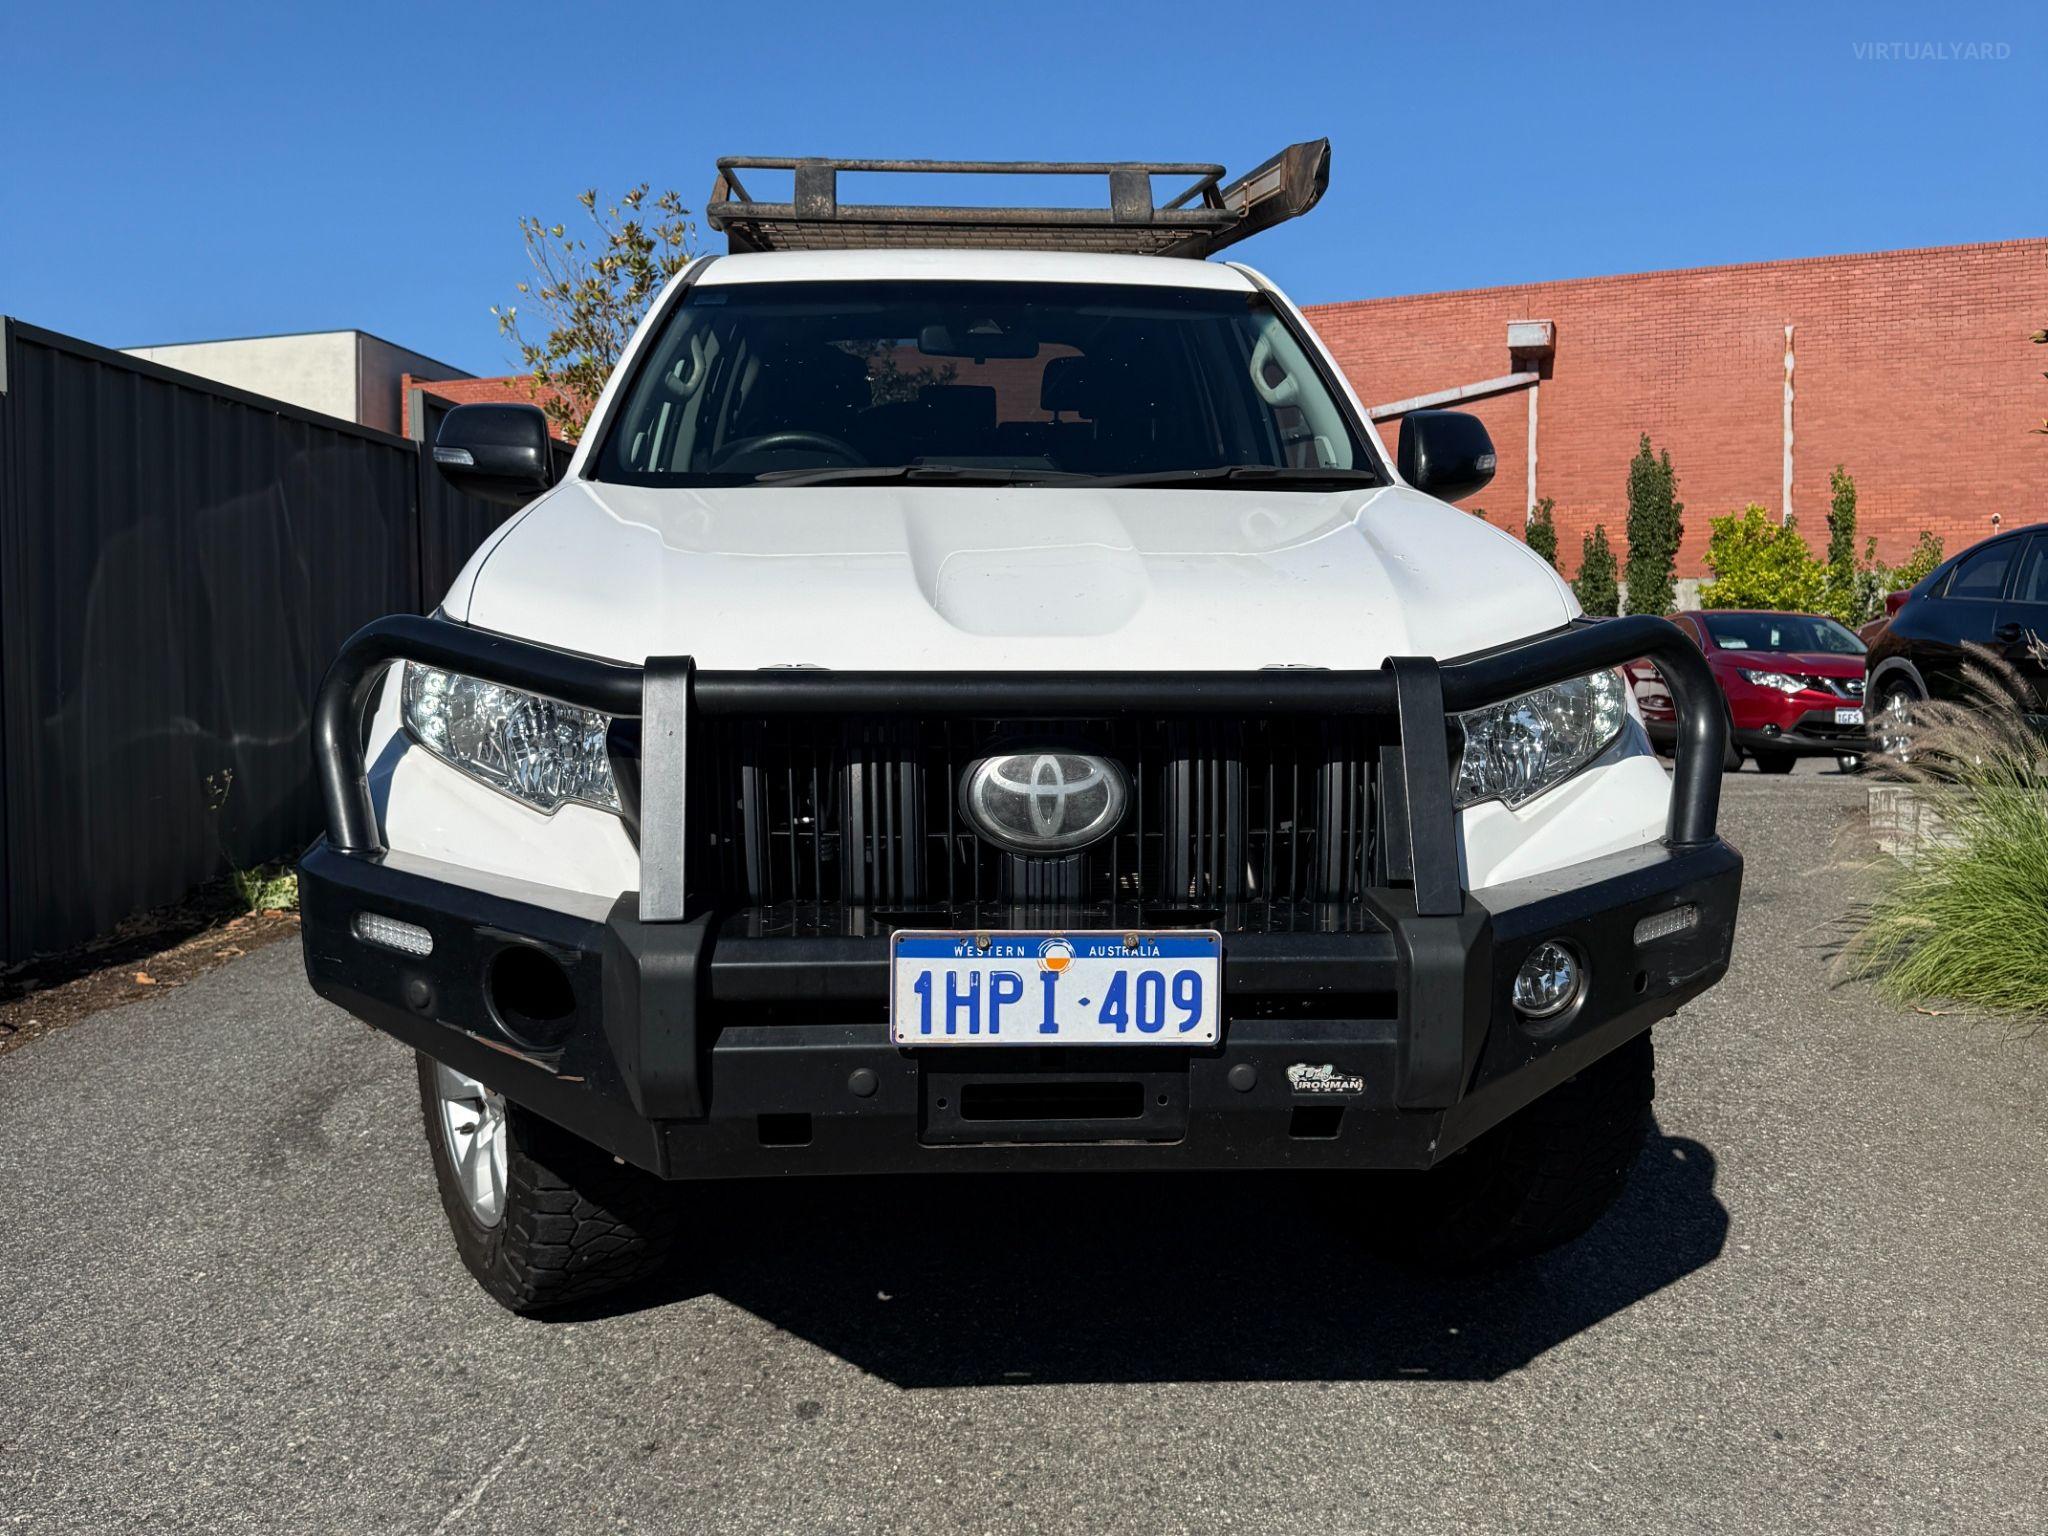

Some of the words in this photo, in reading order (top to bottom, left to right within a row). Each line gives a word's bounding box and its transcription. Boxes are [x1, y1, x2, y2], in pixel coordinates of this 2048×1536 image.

[954, 946, 1025, 957] WESTERN
[1089, 946, 1160, 957] AUSTRALIA
[1299, 1081, 1358, 1089] IRONMAN
